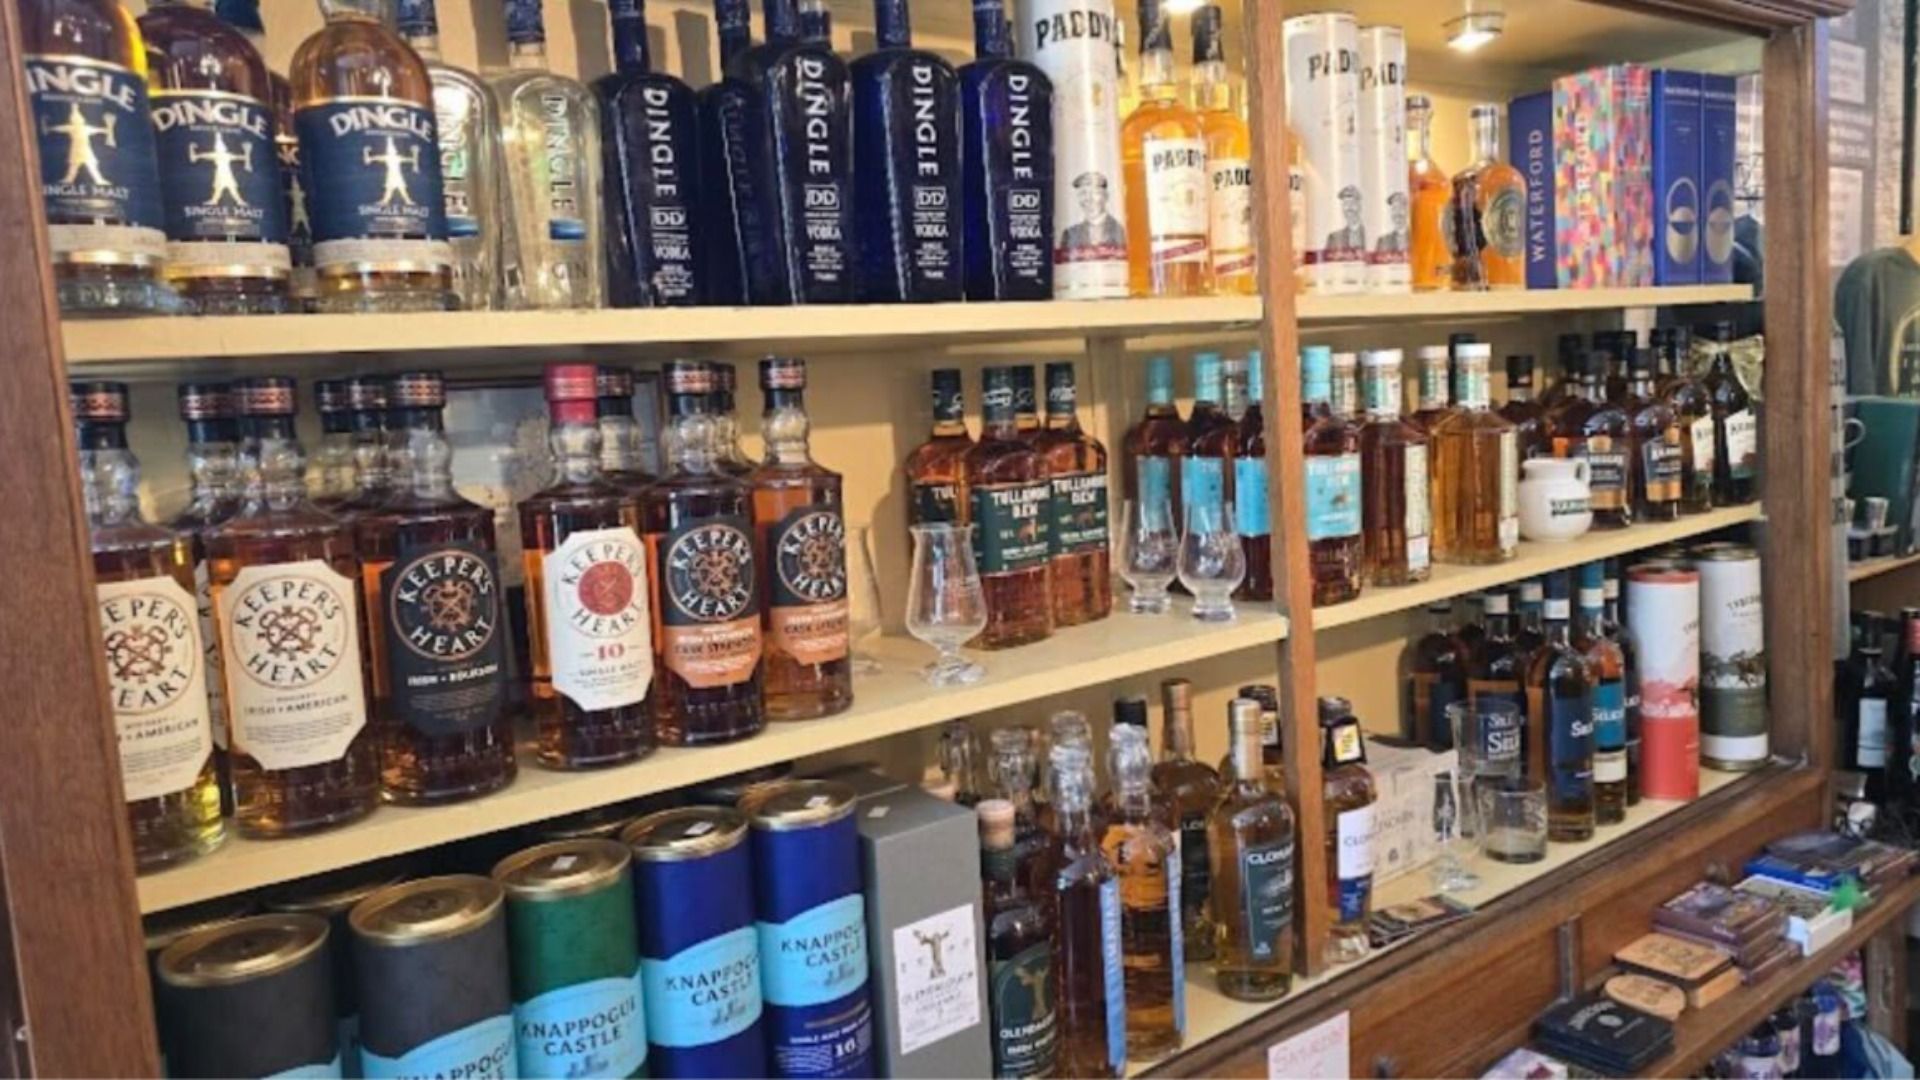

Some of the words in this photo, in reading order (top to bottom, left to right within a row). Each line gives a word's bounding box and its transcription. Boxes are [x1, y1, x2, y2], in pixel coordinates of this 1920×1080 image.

[25, 64, 137, 113] INGLE
[151, 99, 268, 140] DINGLE
[329, 105, 433, 143] DINGLE
[801, 58, 831, 175] DINGLE
[912, 66, 939, 176] DINGLE
[1008, 74, 1033, 180] DINGLE
[542, 94, 577, 216] DINGLE
[643, 87, 677, 198] DINGLE
[42, 183, 87, 198] INGLE
[805, 190, 837, 207] DD
[918, 191, 947, 207] DD
[1012, 193, 1040, 209] DD
[1528, 128, 1546, 264] WATERFORD
[655, 209, 687, 226] DD
[782, 516, 847, 556] KEEPER
[397, 555, 495, 605] KEEPER'S
[680, 582, 752, 617] HEART
[101, 597, 190, 640] EPER'S
[235, 578, 342, 629] KEEPER'S
[570, 600, 645, 633] HEART
[409, 616, 494, 655] HEART
[596, 641, 627, 662] 10
[246, 642, 339, 685] HEART
[112, 665, 190, 710] EART
[284, 693, 350, 715] AMERICAN
[135, 717, 200, 741] AMERICAN
[543, 1025, 623, 1057] CASTLE
